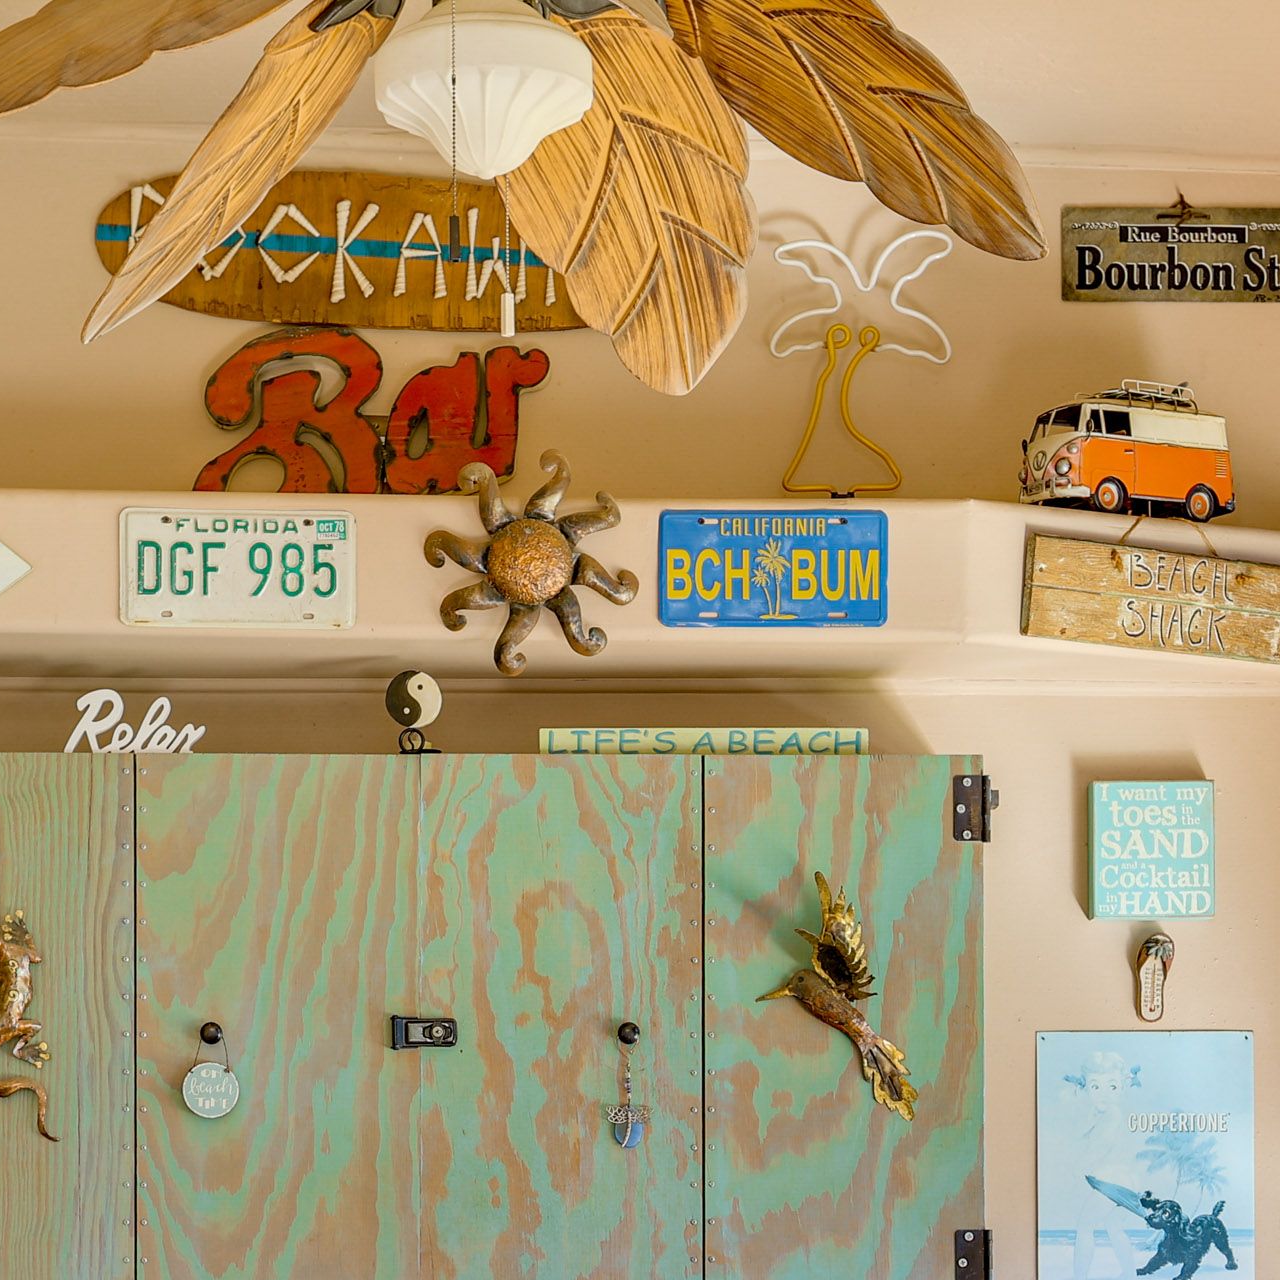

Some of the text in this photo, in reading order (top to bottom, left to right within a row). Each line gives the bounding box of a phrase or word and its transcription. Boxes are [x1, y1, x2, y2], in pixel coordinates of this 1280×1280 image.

[1126, 226, 1239, 244] Rue Bourbon
[1075, 245, 1236, 291] Bourbon
[194, 327, 551, 495] Bar
[175, 517, 299, 534] FLORIDA
[319, 520, 345, 533] OCT 78
[720, 517, 827, 537] CALIFORNIA
[137, 540, 338, 598] DGF 985
[666, 548, 880, 601] BCH BUM
[1126, 553, 1234, 602] BEACH
[1121, 599, 1226, 651] SHACK
[63, 688, 207, 754] Relax
[547, 728, 862, 755] LIFE'S A BEACH
[1099, 783, 1209, 806] I want my
[1108, 800, 1193, 827] toes in
[1181, 815, 1201, 825] the
[1100, 828, 1210, 860] SAND
[1099, 863, 1211, 889] Cocktail
[1121, 861, 1138, 870] and
[1098, 904, 1118, 915] my
[1106, 890, 1211, 915] in HAND
[1127, 1111, 1229, 1133] COPPERTONE
